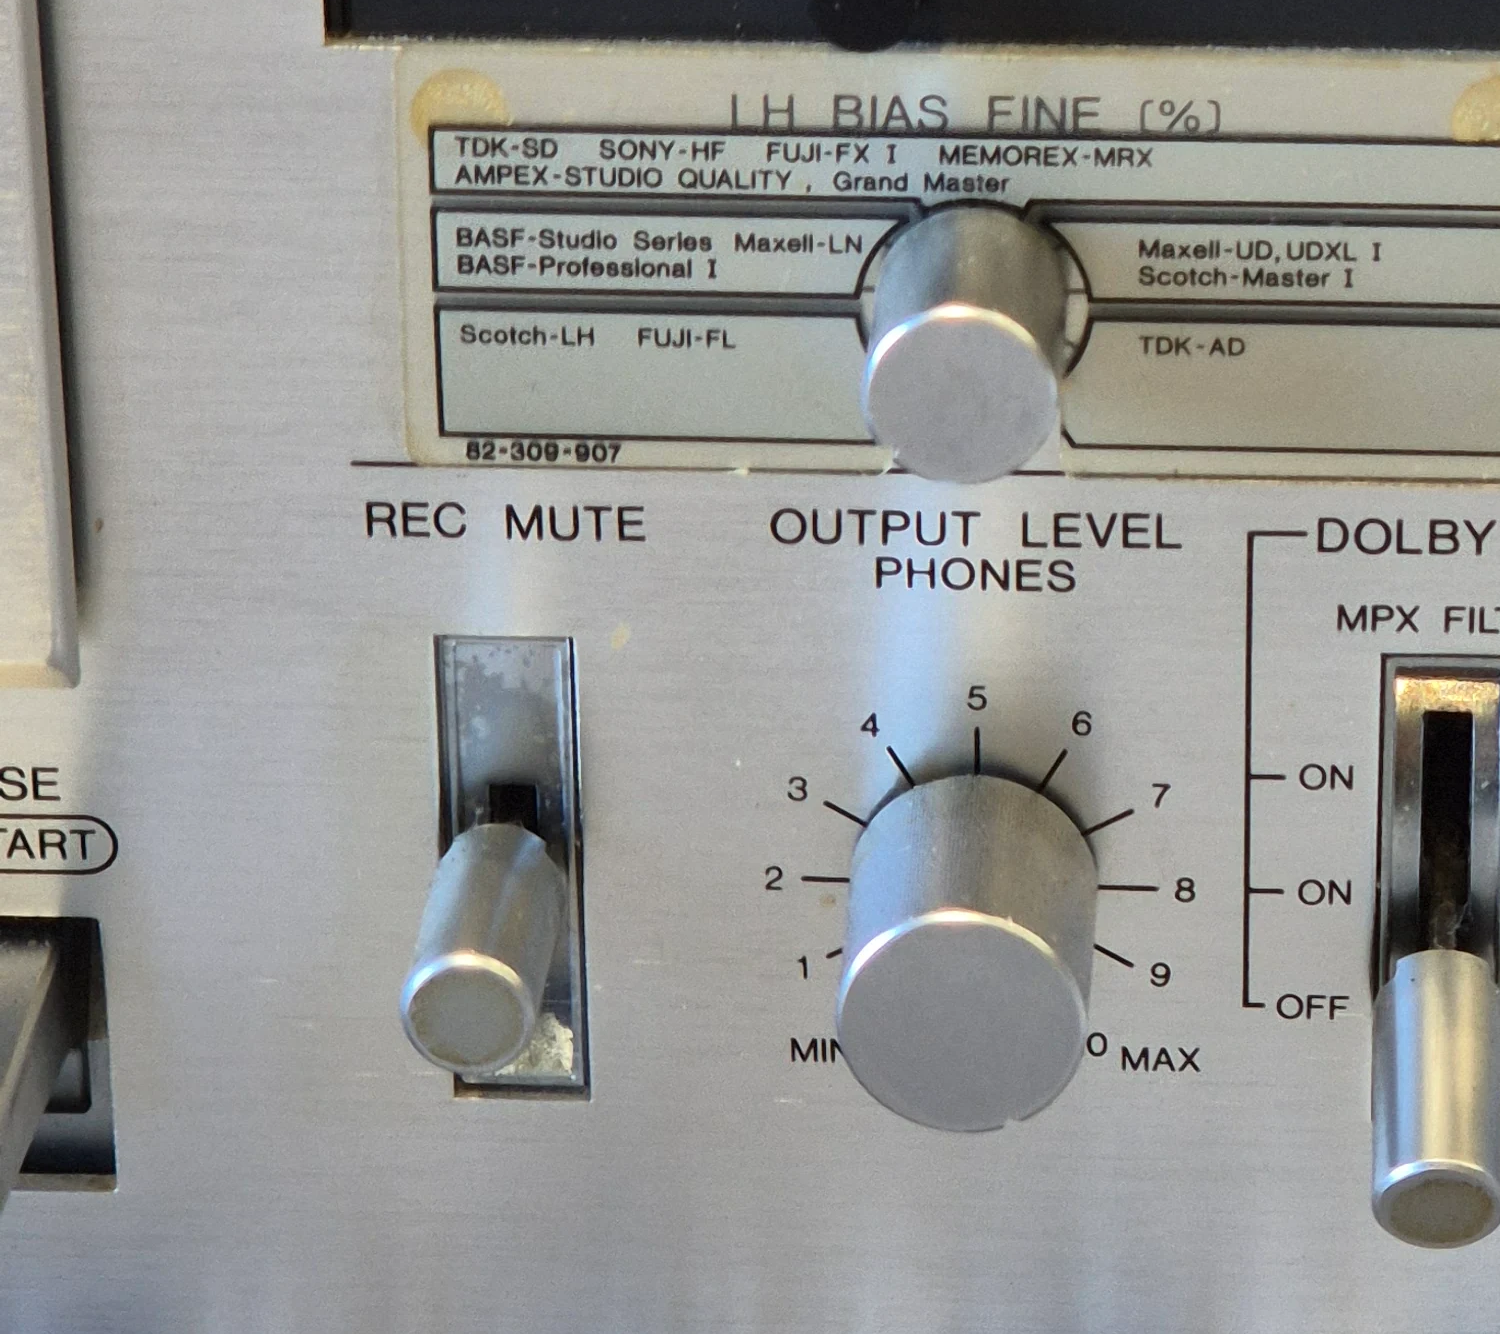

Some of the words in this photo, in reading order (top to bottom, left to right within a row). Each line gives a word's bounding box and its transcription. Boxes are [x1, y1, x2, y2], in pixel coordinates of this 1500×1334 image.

[832, 95, 951, 131] BIAS
[454, 136, 559, 159] TDK-SD
[599, 139, 726, 162] SONY-HF
[766, 142, 870, 163] FUJI-FX
[938, 145, 1153, 168] MEMOREX-MRX
[454, 164, 663, 188] AMPEX-STUDIO
[832, 171, 908, 192] Grand
[923, 173, 1010, 193] Master
[455, 227, 618, 250] BASF-Studio
[632, 230, 713, 252] Series
[734, 233, 863, 255] Maxell-LN
[457, 255, 692, 278] BASF-Professional
[1138, 266, 1330, 288] Scotch-Master
[460, 325, 595, 347] Scotch-LH
[637, 329, 736, 349] FUJI-FL
[1140, 336, 1246, 357] TDK-AD
[465, 440, 622, 464] 82-309-907
[365, 501, 467, 538] REC
[505, 505, 647, 541] MUTE
[770, 508, 981, 547] OUTPUT
[1022, 512, 1182, 549] LEVEL
[1316, 517, 1497, 556] DOLBY
[875, 557, 1077, 592] PHONES
[1337, 604, 1419, 632] MPX
[966, 686, 987, 711] 5
[861, 713, 880, 737] 4
[1071, 711, 1093, 737] 6
[0, 766, 62, 801] SE
[787, 777, 808, 802] 3
[1298, 764, 1354, 791] ON
[1153, 784, 1172, 808] 7
[0, 828, 96, 860] ART
[764, 867, 784, 891] 2
[1174, 878, 1196, 903] 8
[1297, 879, 1353, 906] ON
[798, 957, 809, 980] 1
[1150, 963, 1171, 988] 9
[1275, 995, 1350, 1020] OFF
[1121, 1047, 1202, 1073] MAX
